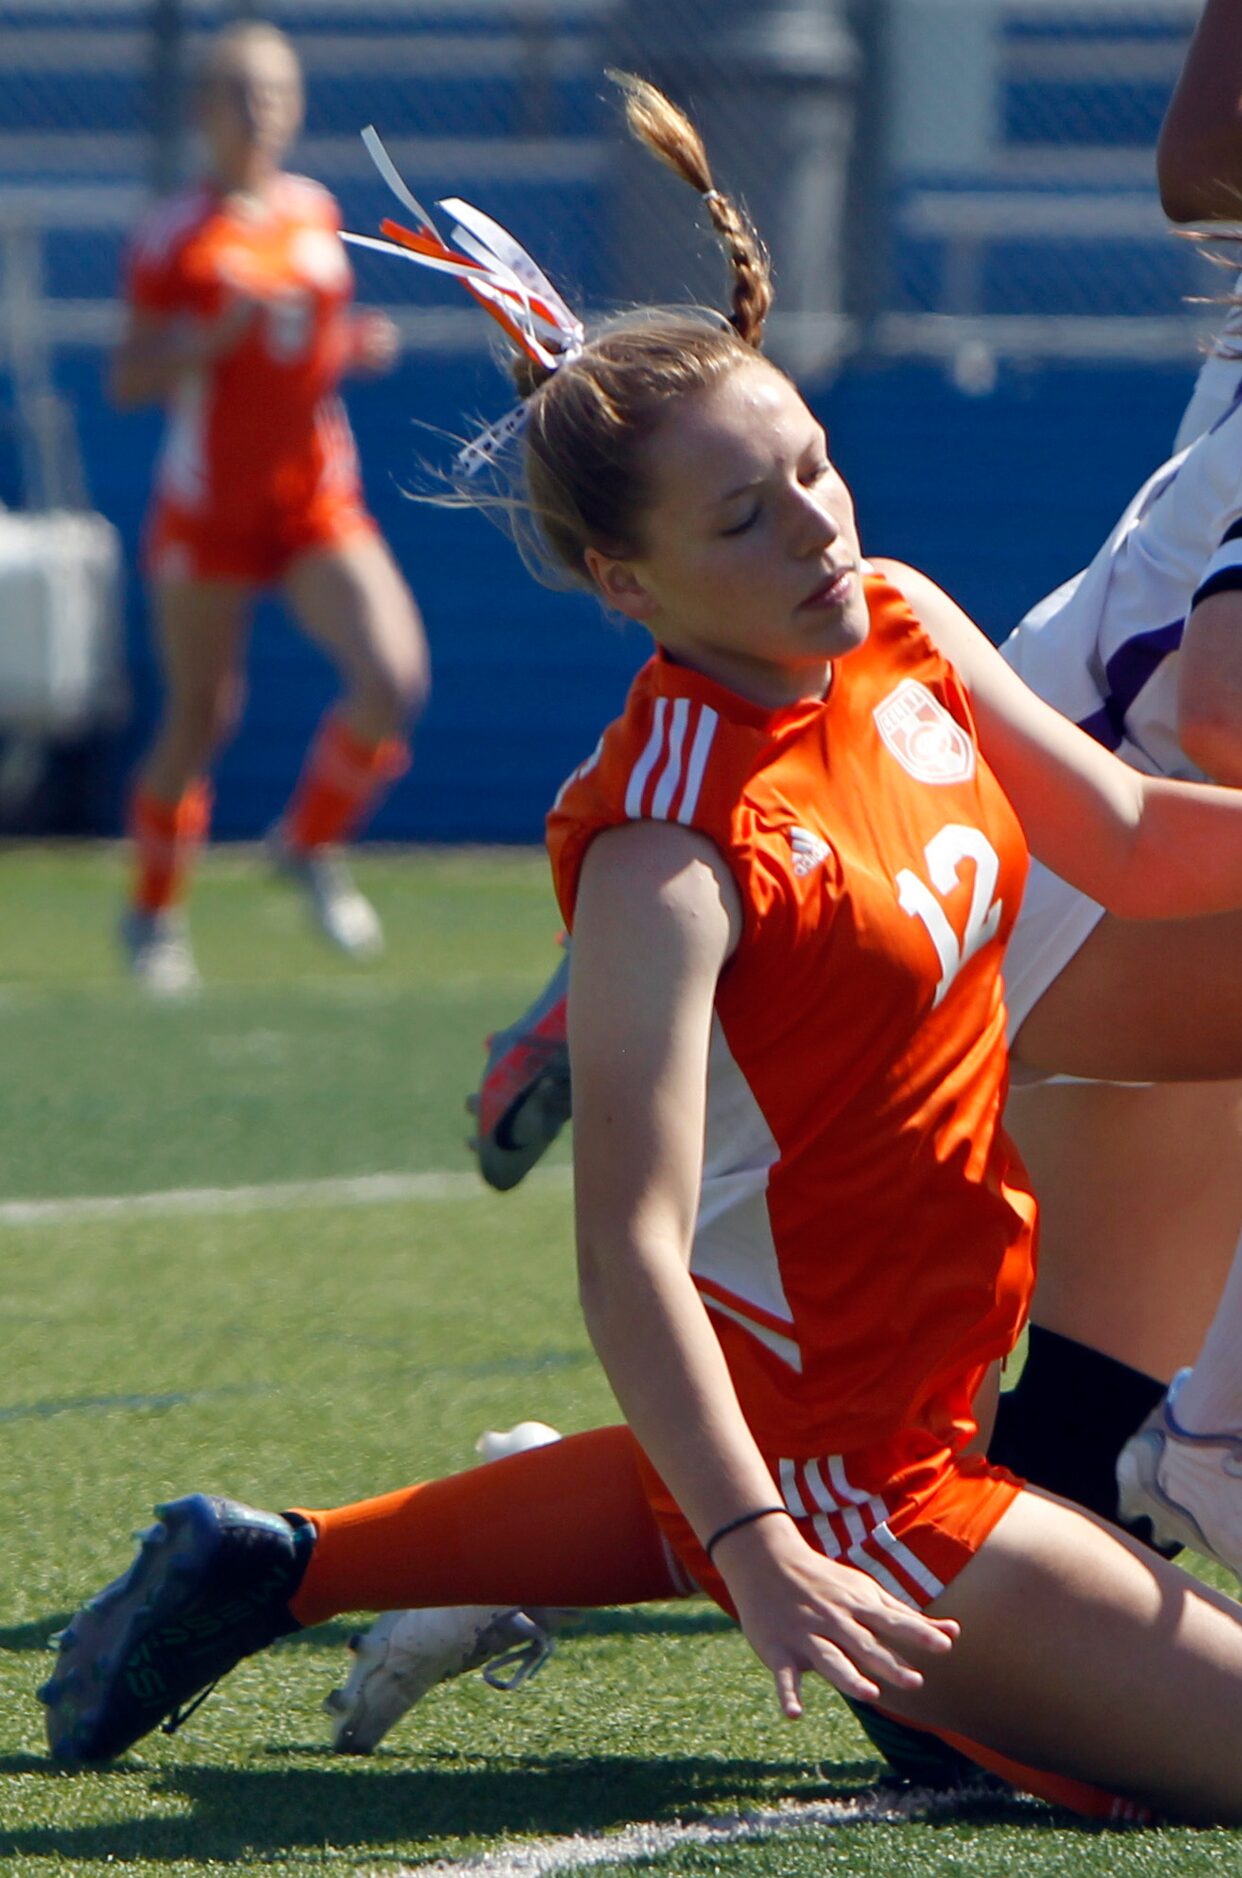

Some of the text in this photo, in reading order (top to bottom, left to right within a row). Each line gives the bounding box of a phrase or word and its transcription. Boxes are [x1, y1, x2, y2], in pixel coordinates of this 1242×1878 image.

[881, 688, 924, 733] CELINA
[793, 844, 832, 878] adida
[896, 823, 1003, 1011] 12
